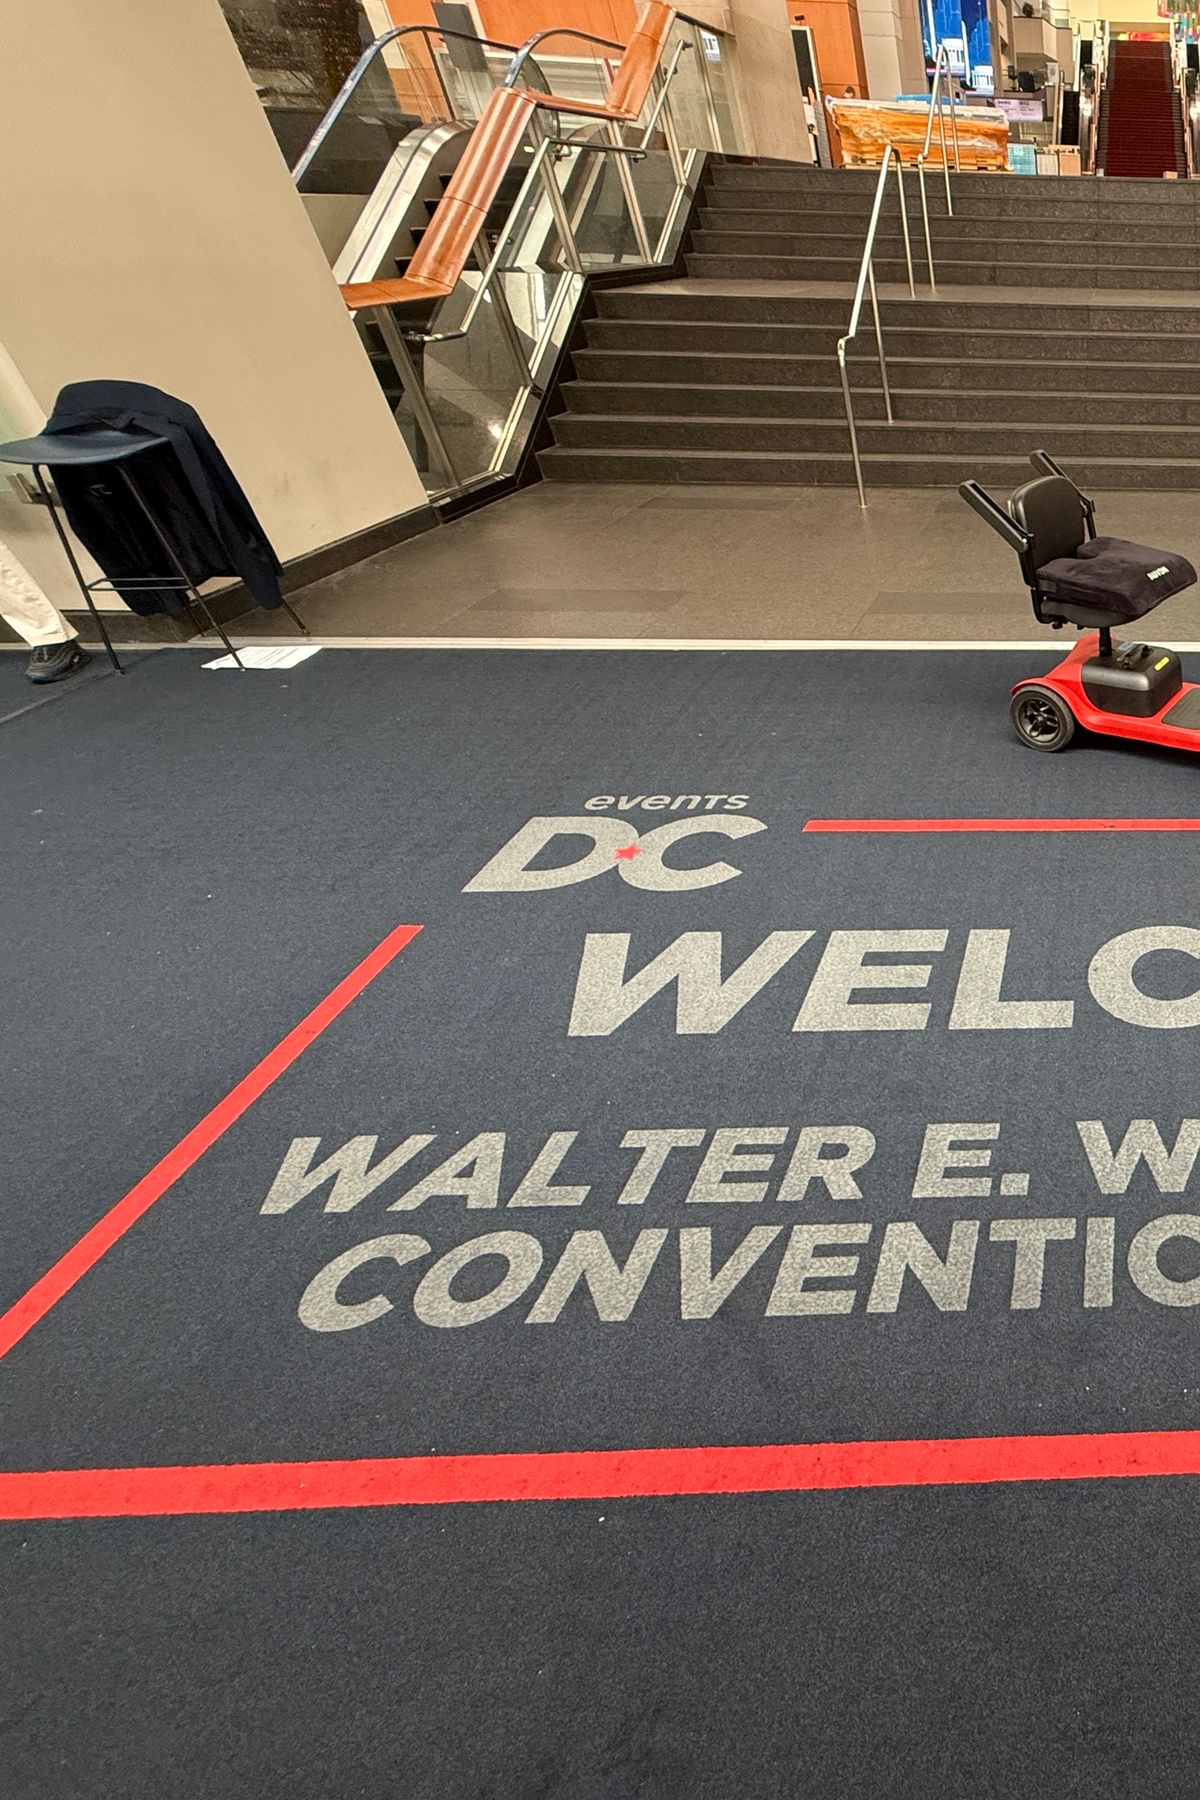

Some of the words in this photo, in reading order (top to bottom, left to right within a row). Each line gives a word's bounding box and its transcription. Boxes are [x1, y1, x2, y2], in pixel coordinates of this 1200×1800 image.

[584, 794, 750, 811] events
[461, 814, 768, 893] DC
[260, 1123, 877, 1215] WALTER
[912, 1122, 1030, 1198] E.
